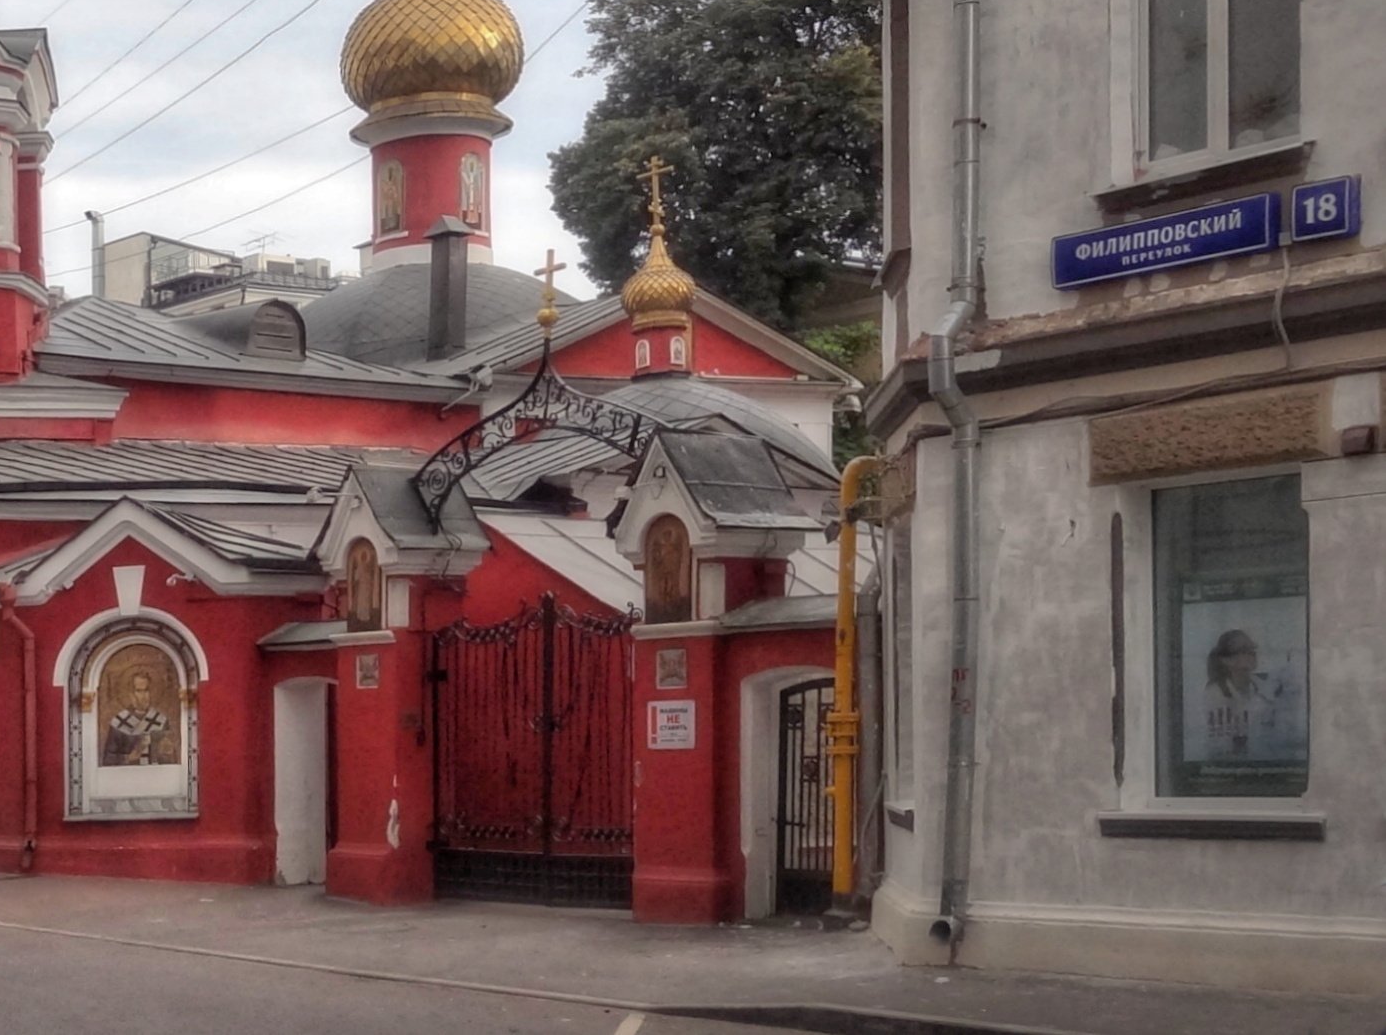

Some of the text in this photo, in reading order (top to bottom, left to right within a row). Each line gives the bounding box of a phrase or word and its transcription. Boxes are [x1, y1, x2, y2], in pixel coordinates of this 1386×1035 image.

[1302, 192, 1338, 225] 18
[1075, 208, 1243, 262] ФИЛИППОВСКИЙ
[1121, 243, 1192, 267] ПЕРЕУЛОК
[666, 714, 681, 724] НЕ
